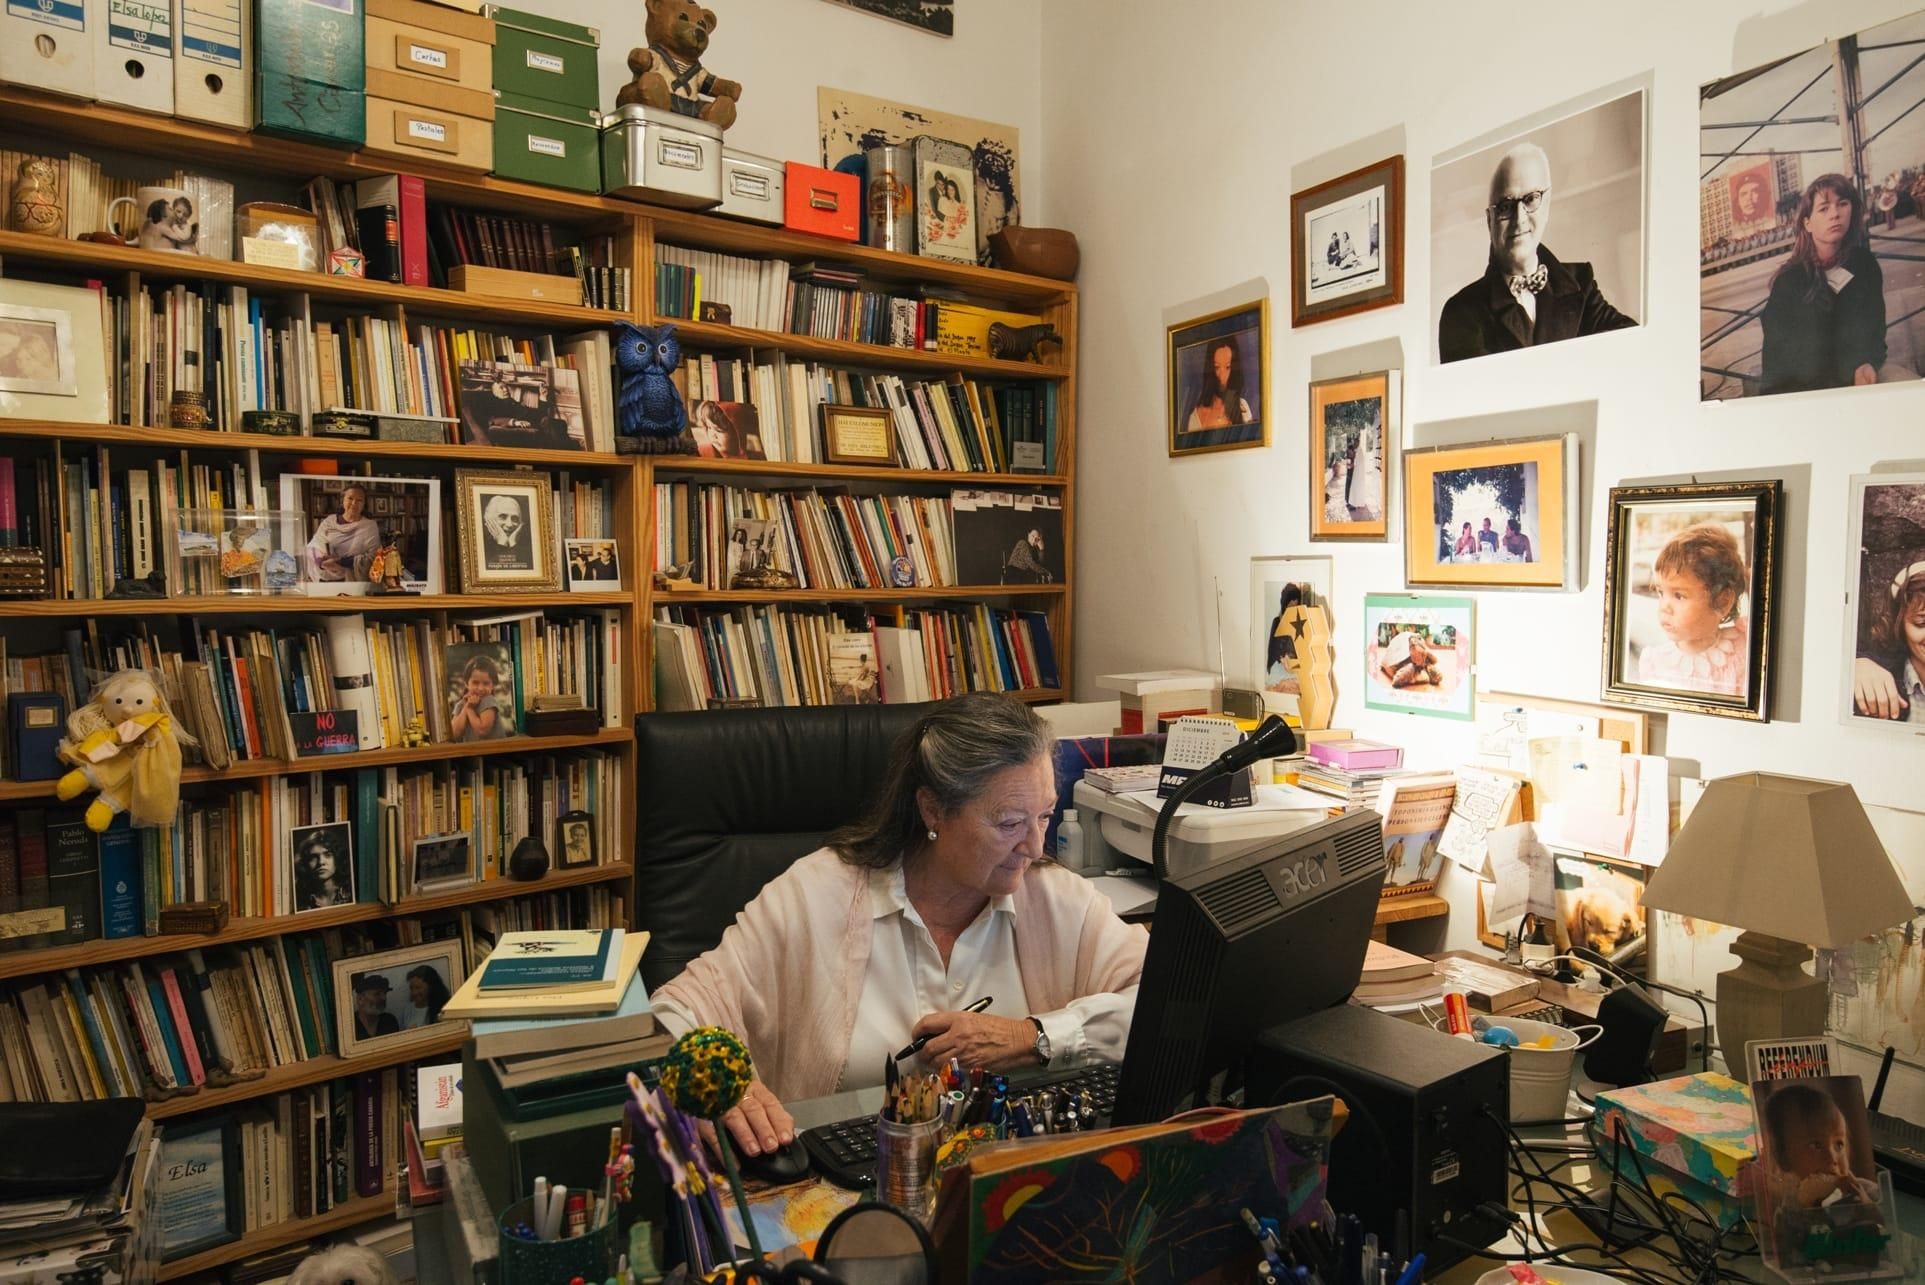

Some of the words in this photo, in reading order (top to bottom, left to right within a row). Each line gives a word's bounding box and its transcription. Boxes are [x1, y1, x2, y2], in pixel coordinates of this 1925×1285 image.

[111, 1, 138, 18] Elsa
[415, 50, 441, 63] Cartas
[315, 712, 336, 731] NO
[1183, 726, 1210, 734] DICIEMBRE
[315, 733, 356, 748] GUERRA
[62, 829, 86, 838] Pablo
[58, 838, 88, 847] Neruda
[1280, 854, 1327, 898] acer
[1757, 1043, 1831, 1081] REFERENDUM
[168, 1160, 208, 1181] Elsa
